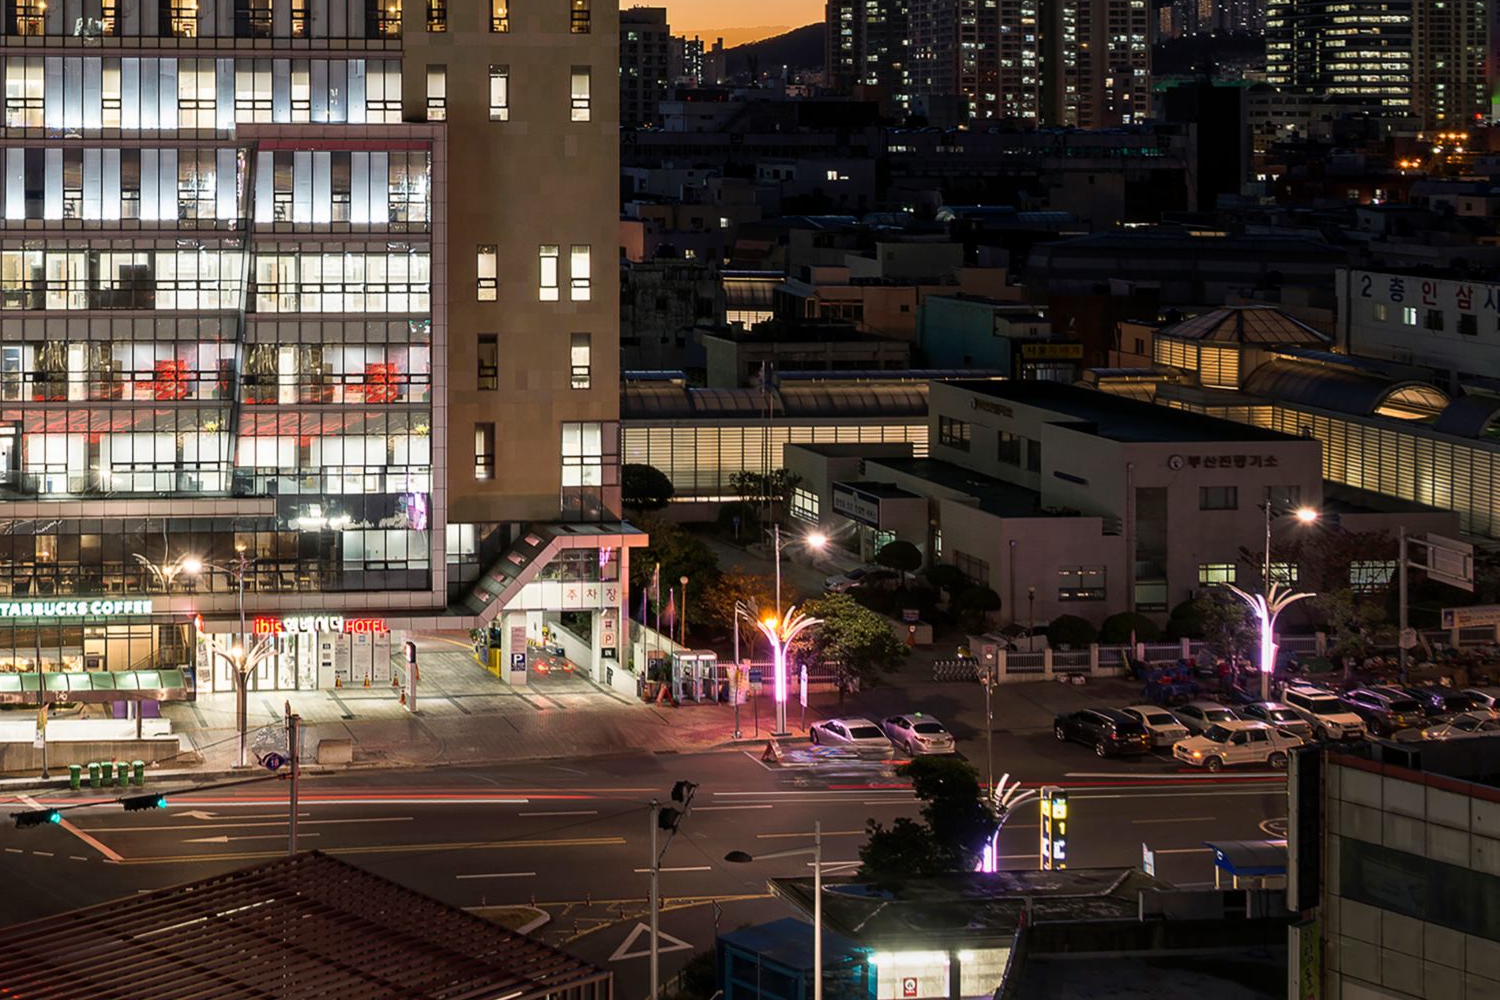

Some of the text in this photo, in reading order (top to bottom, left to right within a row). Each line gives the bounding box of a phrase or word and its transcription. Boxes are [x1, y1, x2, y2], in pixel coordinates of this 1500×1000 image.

[566, 588, 617, 602] 주차장
[90, 600, 153, 616] COFFEE
[255, 618, 283, 635] ibis
[345, 619, 389, 633] HOTEL
[514, 654, 523, 664] P
